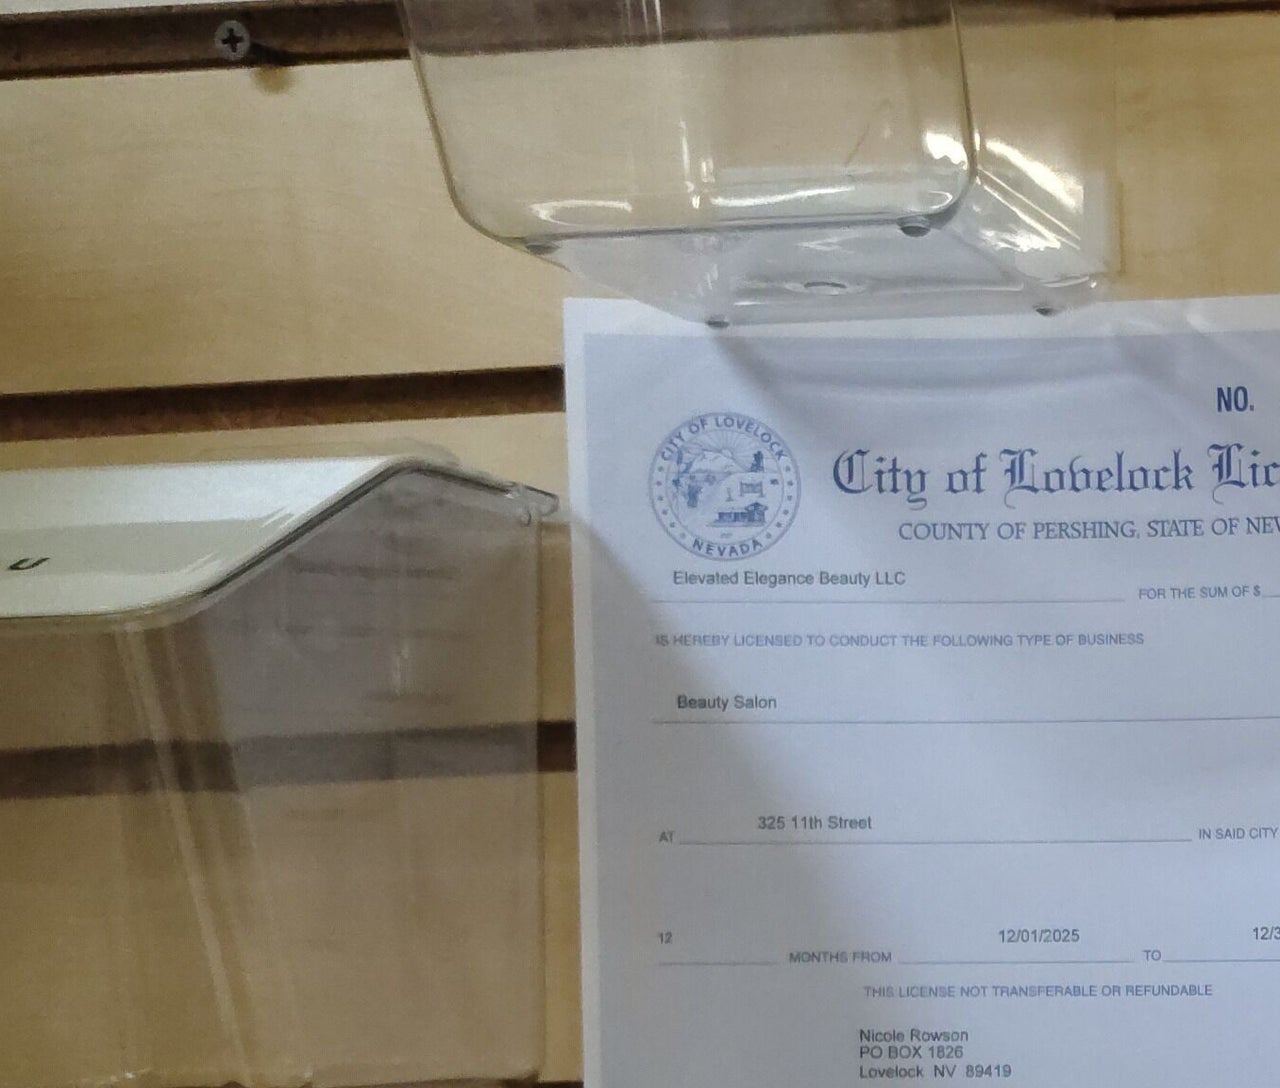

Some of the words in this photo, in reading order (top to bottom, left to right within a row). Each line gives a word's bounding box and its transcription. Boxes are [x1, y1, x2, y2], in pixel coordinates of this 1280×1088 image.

[1216, 385, 1254, 413] NO.
[661, 431, 685, 461] CITY
[689, 418, 708, 434] OF
[715, 417, 787, 460] LOVELOCK
[832, 448, 928, 511] City
[945, 452, 988, 495] of
[999, 448, 1195, 508] Lovelock
[898, 522, 990, 541] COUNTY
[996, 521, 1027, 540] OF
[1146, 518, 1205, 538] STATE
[1210, 517, 1240, 536] OF
[693, 538, 763, 557] NEVADA
[672, 570, 739, 585] Elevated
[743, 570, 815, 589] Elegance
[819, 570, 871, 589] Beauty
[875, 571, 906, 586] LLC
[1138, 587, 1167, 600] FOR
[1169, 586, 1196, 600] THE
[1199, 585, 1228, 599] SUM
[1231, 583, 1250, 598] OF
[676, 694, 729, 713] Beauty
[733, 694, 777, 710] Salon
[757, 815, 786, 830] 325
[791, 815, 823, 830] 11th
[827, 815, 872, 830] Street
[658, 830, 675, 843] AT
[657, 931, 673, 945] 12
[998, 928, 1080, 944] 12/01/2025
[788, 951, 848, 964] MONTHS
[852, 950, 892, 964] FROM
[1142, 949, 1162, 962] TO
[863, 986, 895, 998] THIS
[898, 985, 956, 998] LICENSE
[959, 985, 988, 998] NOT
[991, 984, 1098, 998] TRANSFERABLE
[1101, 984, 1122, 997] OR
[1125, 983, 1213, 997] REFUNDABLE
[859, 1028, 905, 1043] Nicole
[910, 1028, 969, 1043] Rowson
[859, 1045, 883, 1060] PO
[888, 1044, 923, 1060] BOX
[928, 1044, 964, 1060] 1826
[859, 1064, 924, 1079] Lovelock
[933, 1064, 957, 1078] NV
[965, 1063, 1012, 1078] 89419
